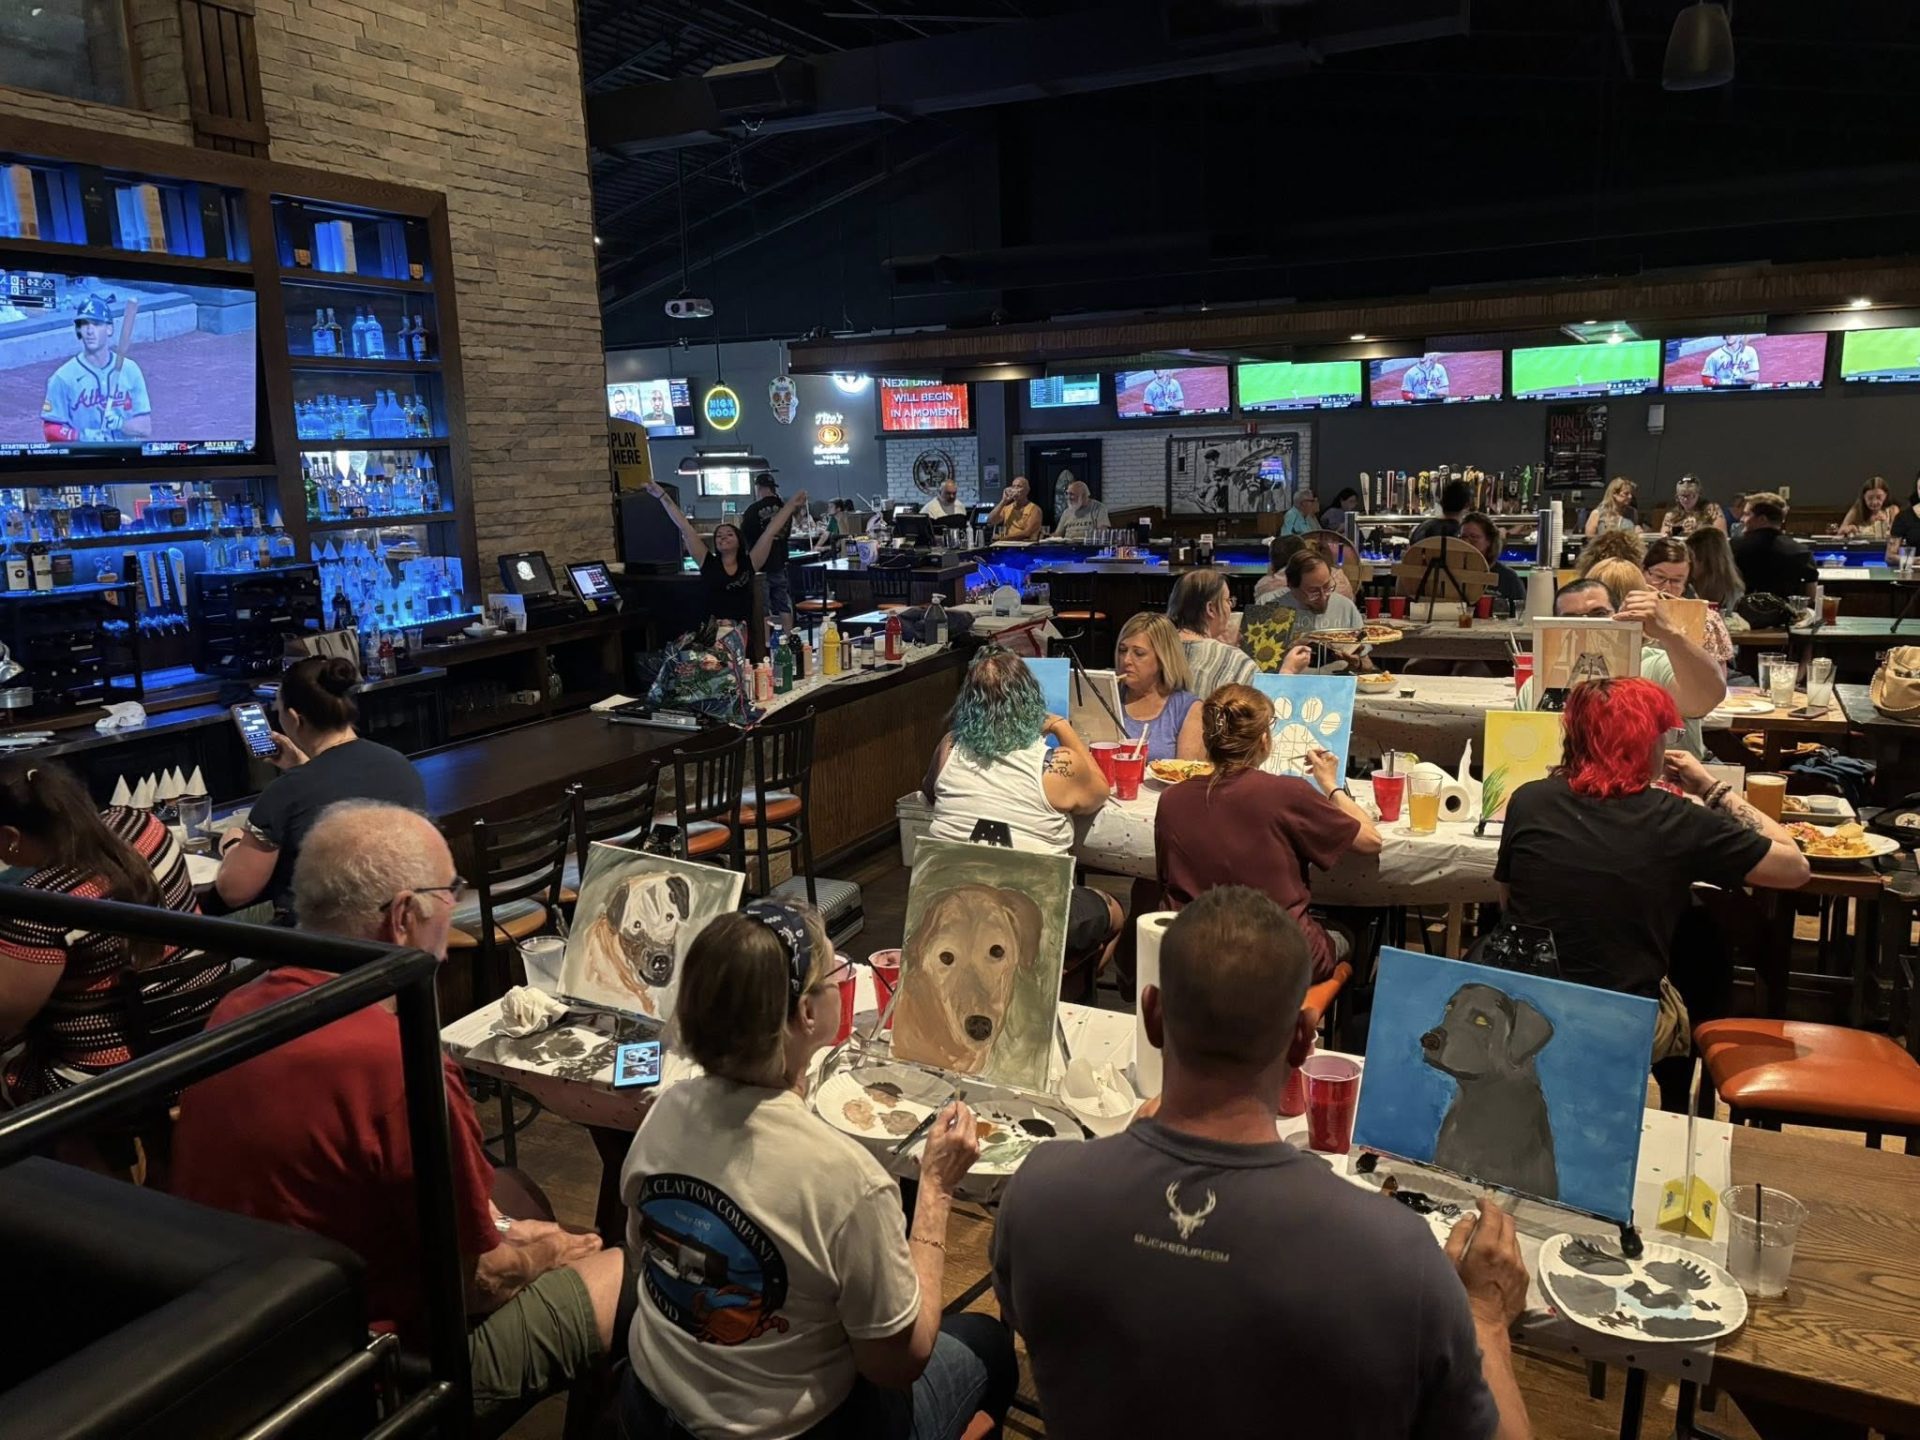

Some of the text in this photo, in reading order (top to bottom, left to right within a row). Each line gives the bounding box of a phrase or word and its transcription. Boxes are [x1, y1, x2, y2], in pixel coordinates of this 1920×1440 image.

[882, 377, 910, 388] NEXT
[893, 391, 954, 403] WILL BEGIN
[709, 399, 734, 409] HIGH
[708, 408, 736, 418] NOON
[890, 406, 960, 418] IN A MOMENT
[611, 431, 637, 448] PLAY
[612, 449, 642, 465] HERE
[653, 1179, 715, 1205] CLAYTON
[717, 1198, 775, 1263] COMPANY
